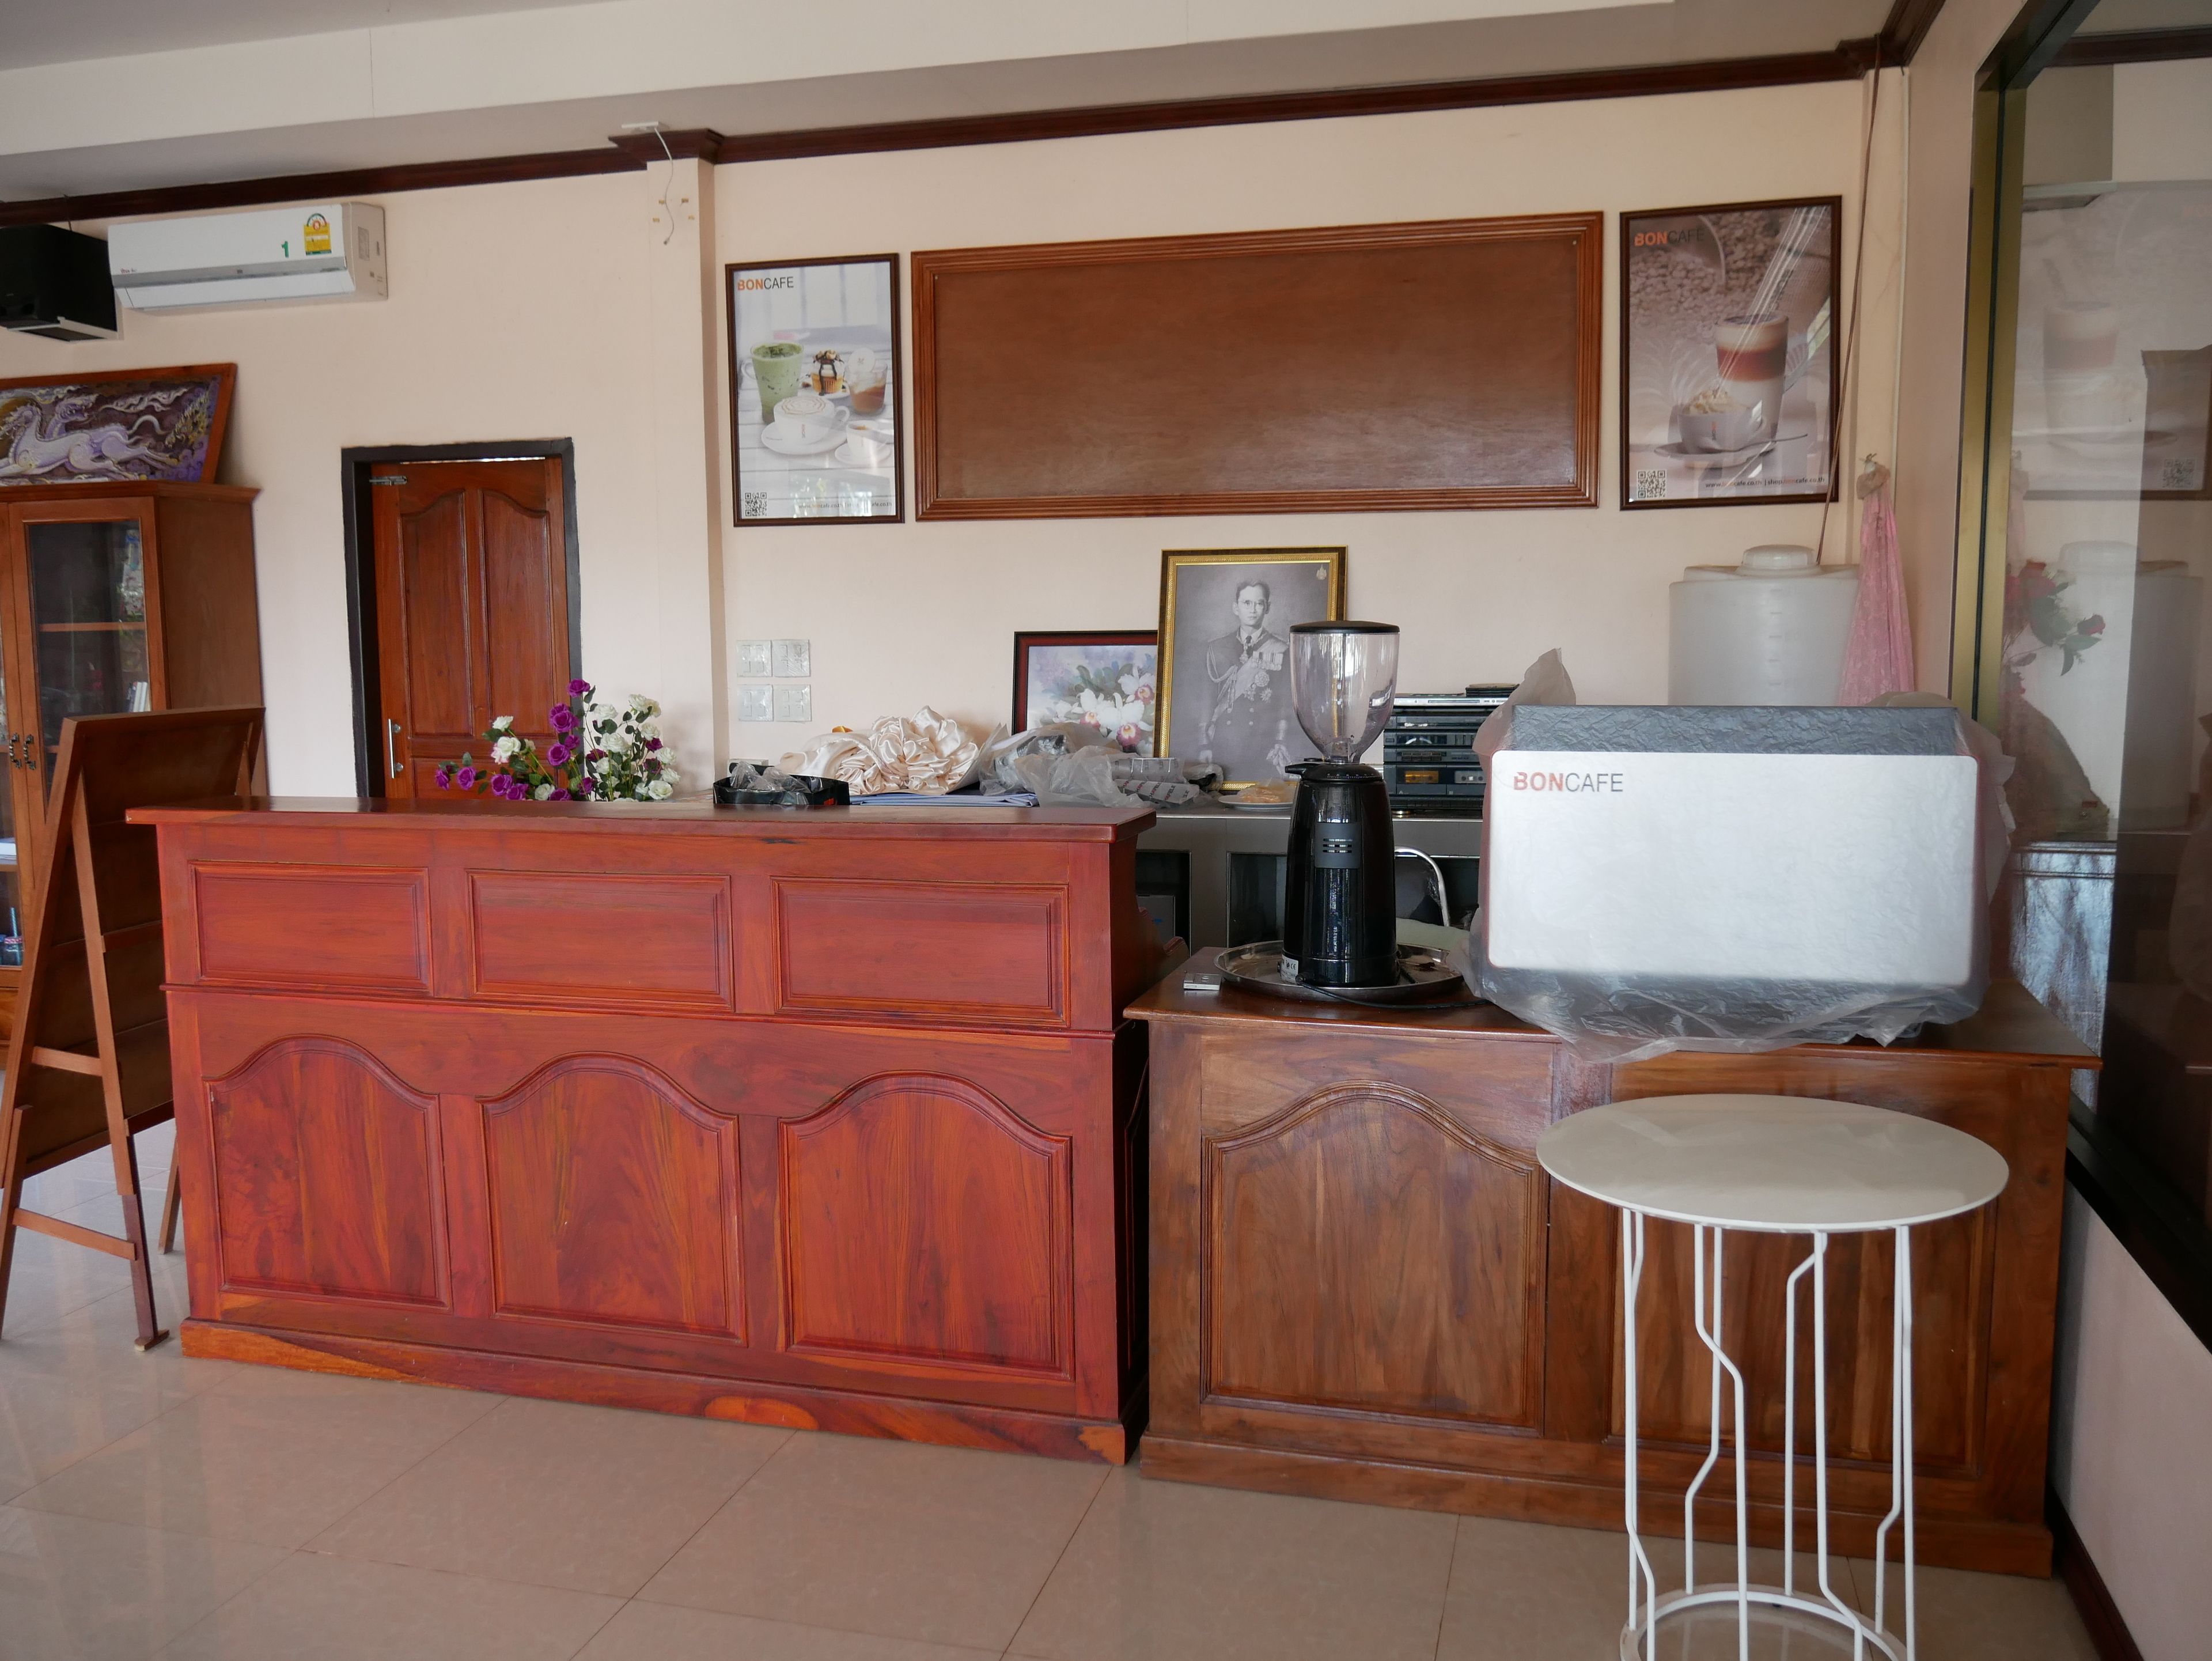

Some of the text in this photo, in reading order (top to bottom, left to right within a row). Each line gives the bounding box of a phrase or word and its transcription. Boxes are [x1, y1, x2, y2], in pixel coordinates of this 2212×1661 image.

[1634, 229, 1705, 247] BONCAFE
[281, 240, 289, 258] 1
[737, 276, 794, 291] BONCAFE
[1705, 479, 1762, 488] www.bcafe.co.th
[1513, 771, 1623, 792] BONCAFE
